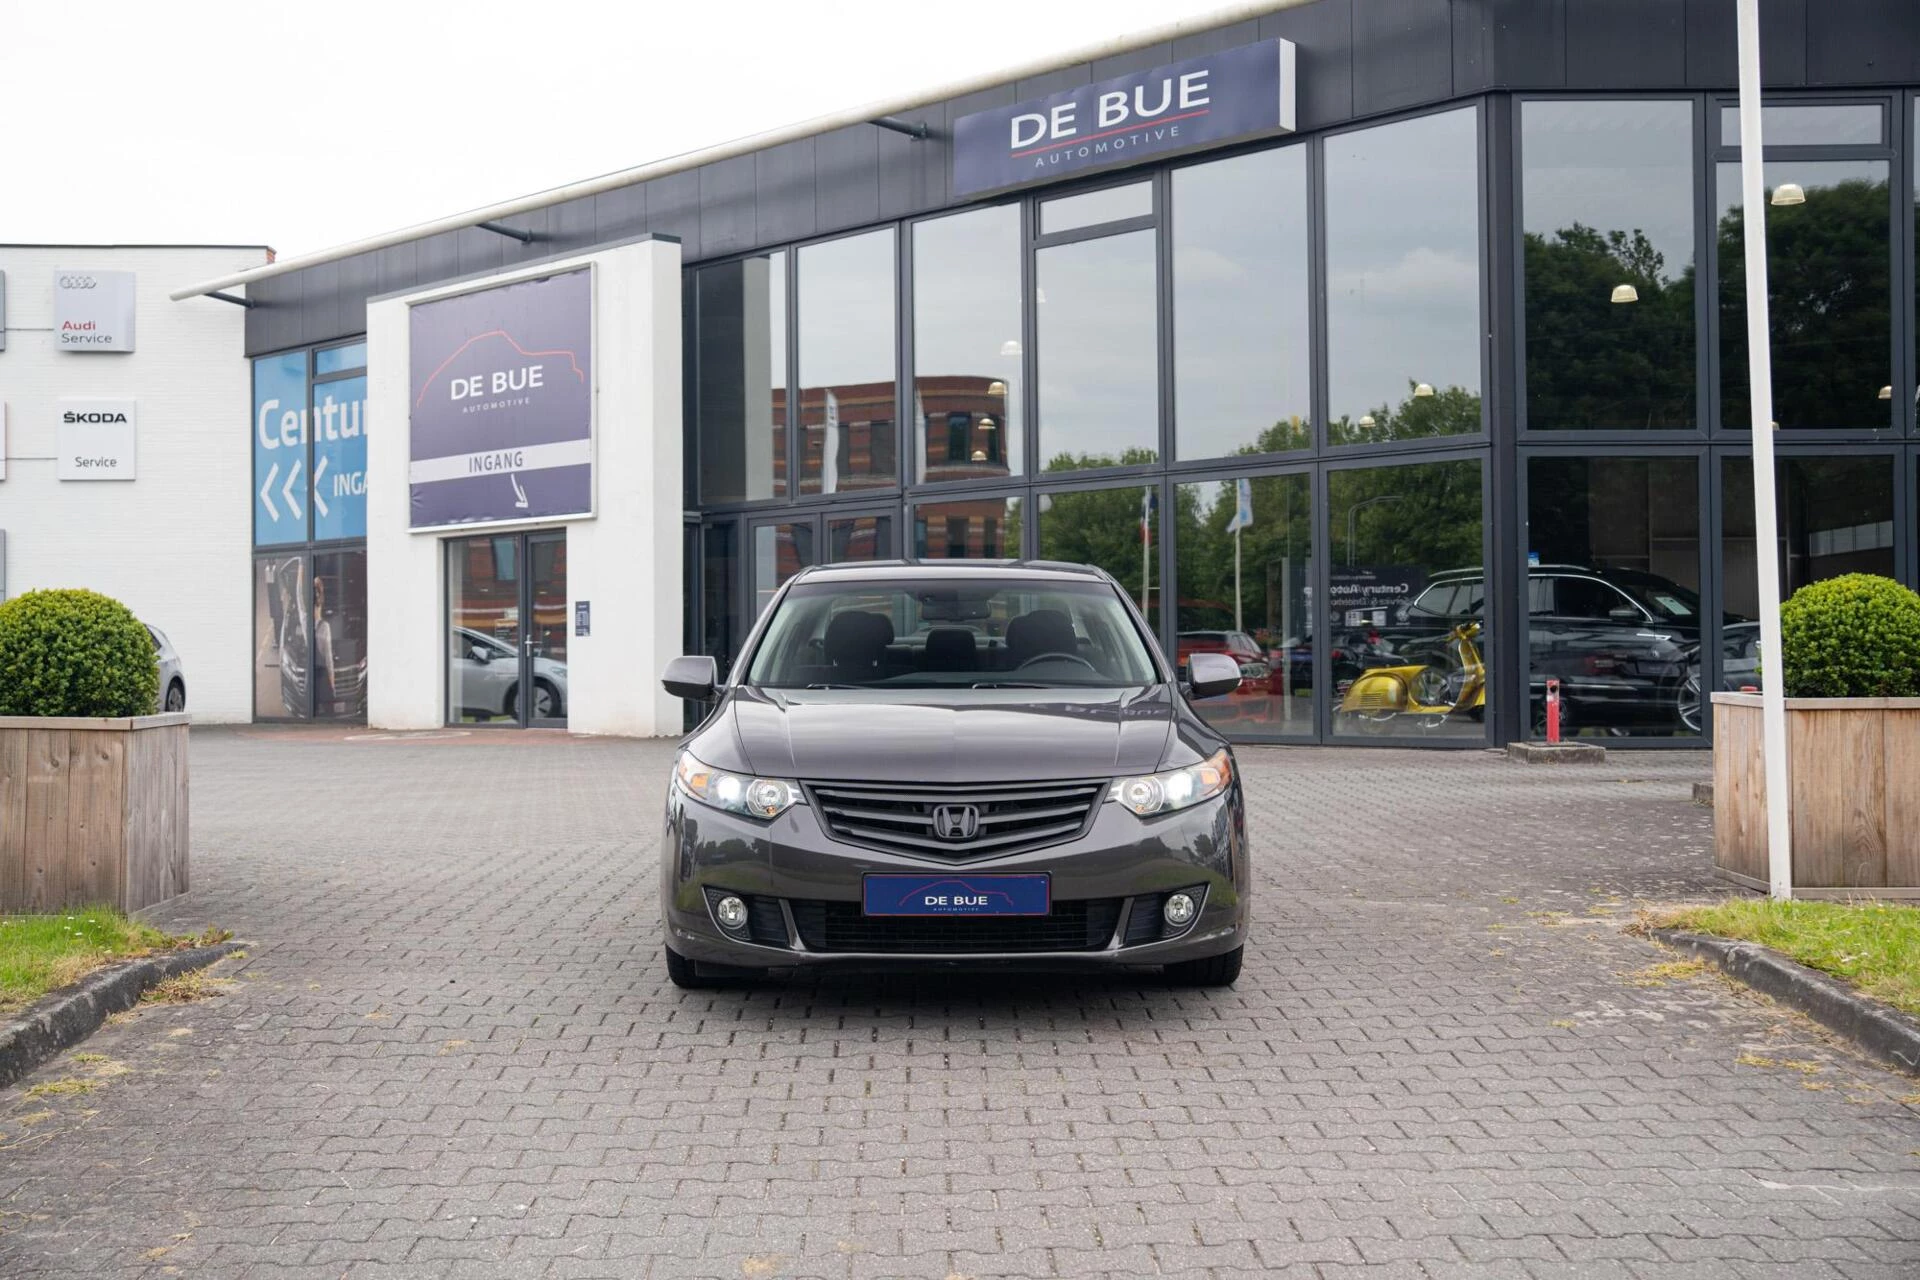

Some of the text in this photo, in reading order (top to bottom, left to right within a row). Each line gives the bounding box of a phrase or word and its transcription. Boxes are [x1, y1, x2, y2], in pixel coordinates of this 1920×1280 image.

[1011, 69, 1210, 149] DE BUE
[1035, 125, 1180, 168] AUTOMOTIVE
[62, 320, 96, 331] Audi
[61, 332, 112, 344] Service
[451, 365, 544, 401] DE BUE
[462, 397, 531, 414] AUTOMOTIVE
[63, 411, 127, 424] ŠKODA
[259, 395, 367, 450] Centu
[75, 456, 117, 468] Service
[469, 451, 523, 473] INGANG
[924, 896, 988, 906] DE BUE
